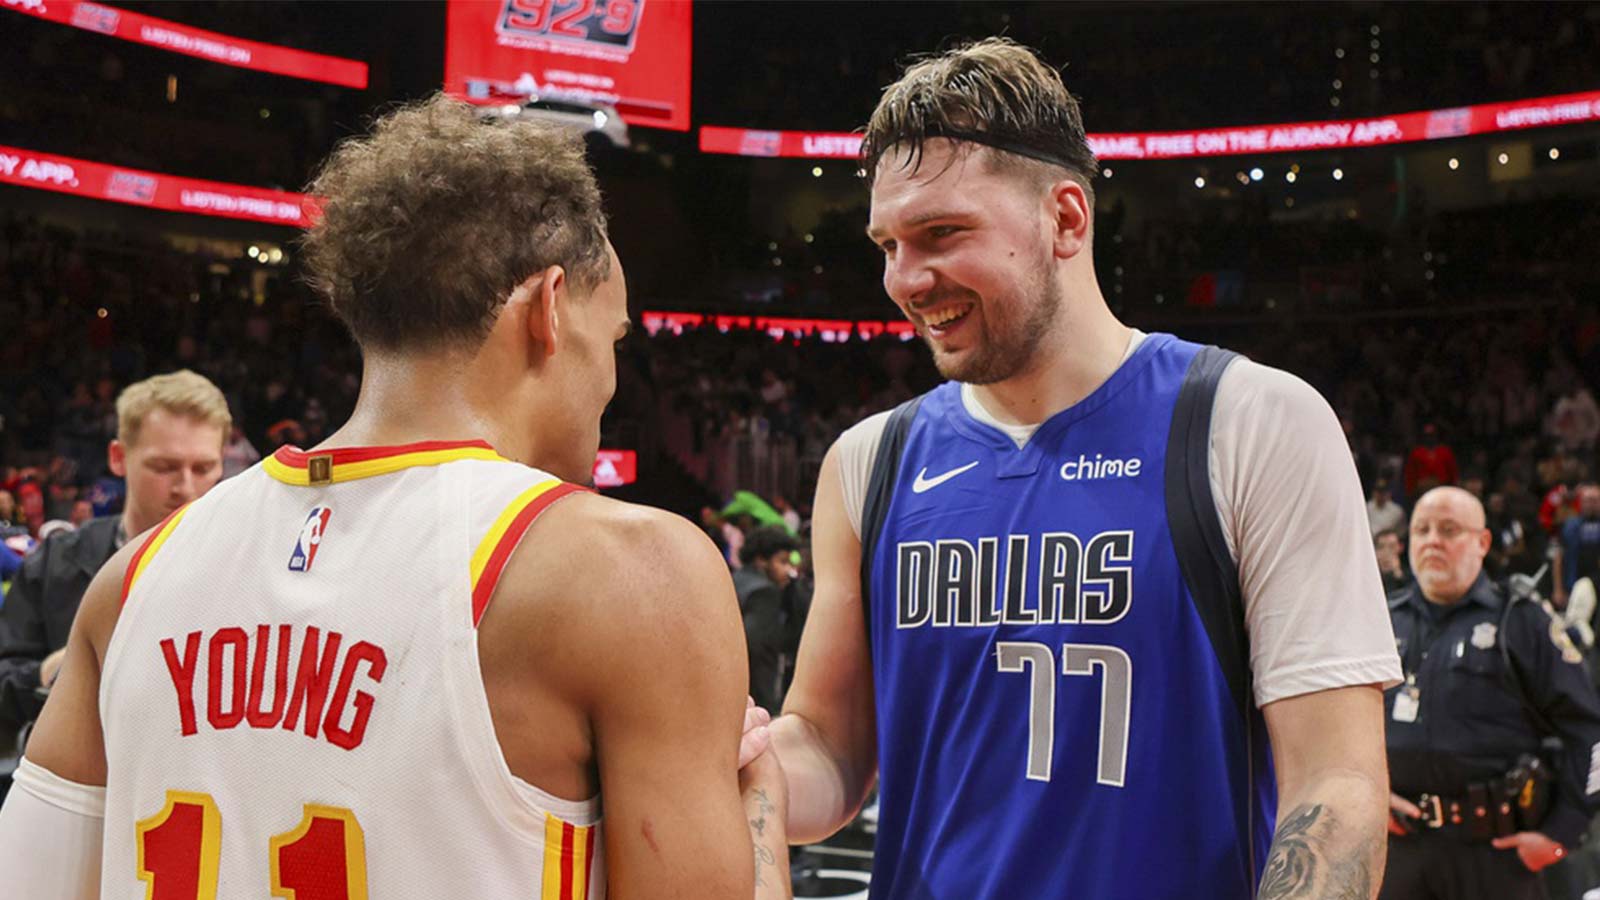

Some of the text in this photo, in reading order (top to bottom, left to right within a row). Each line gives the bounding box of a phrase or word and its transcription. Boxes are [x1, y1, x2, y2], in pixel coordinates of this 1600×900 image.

[803, 135, 861, 156] LISTE
[1146, 134, 1194, 156] FREE
[1196, 132, 1227, 154] ON
[1228, 129, 1267, 152] THE
[1269, 123, 1352, 149] AUDACY
[1352, 119, 1403, 143] APP.
[20, 158, 79, 188] APP.
[1060, 453, 1142, 481] chime
[896, 530, 1134, 629] DALLAS
[159, 623, 388, 751] YOUNG
[995, 641, 1132, 788] 77
